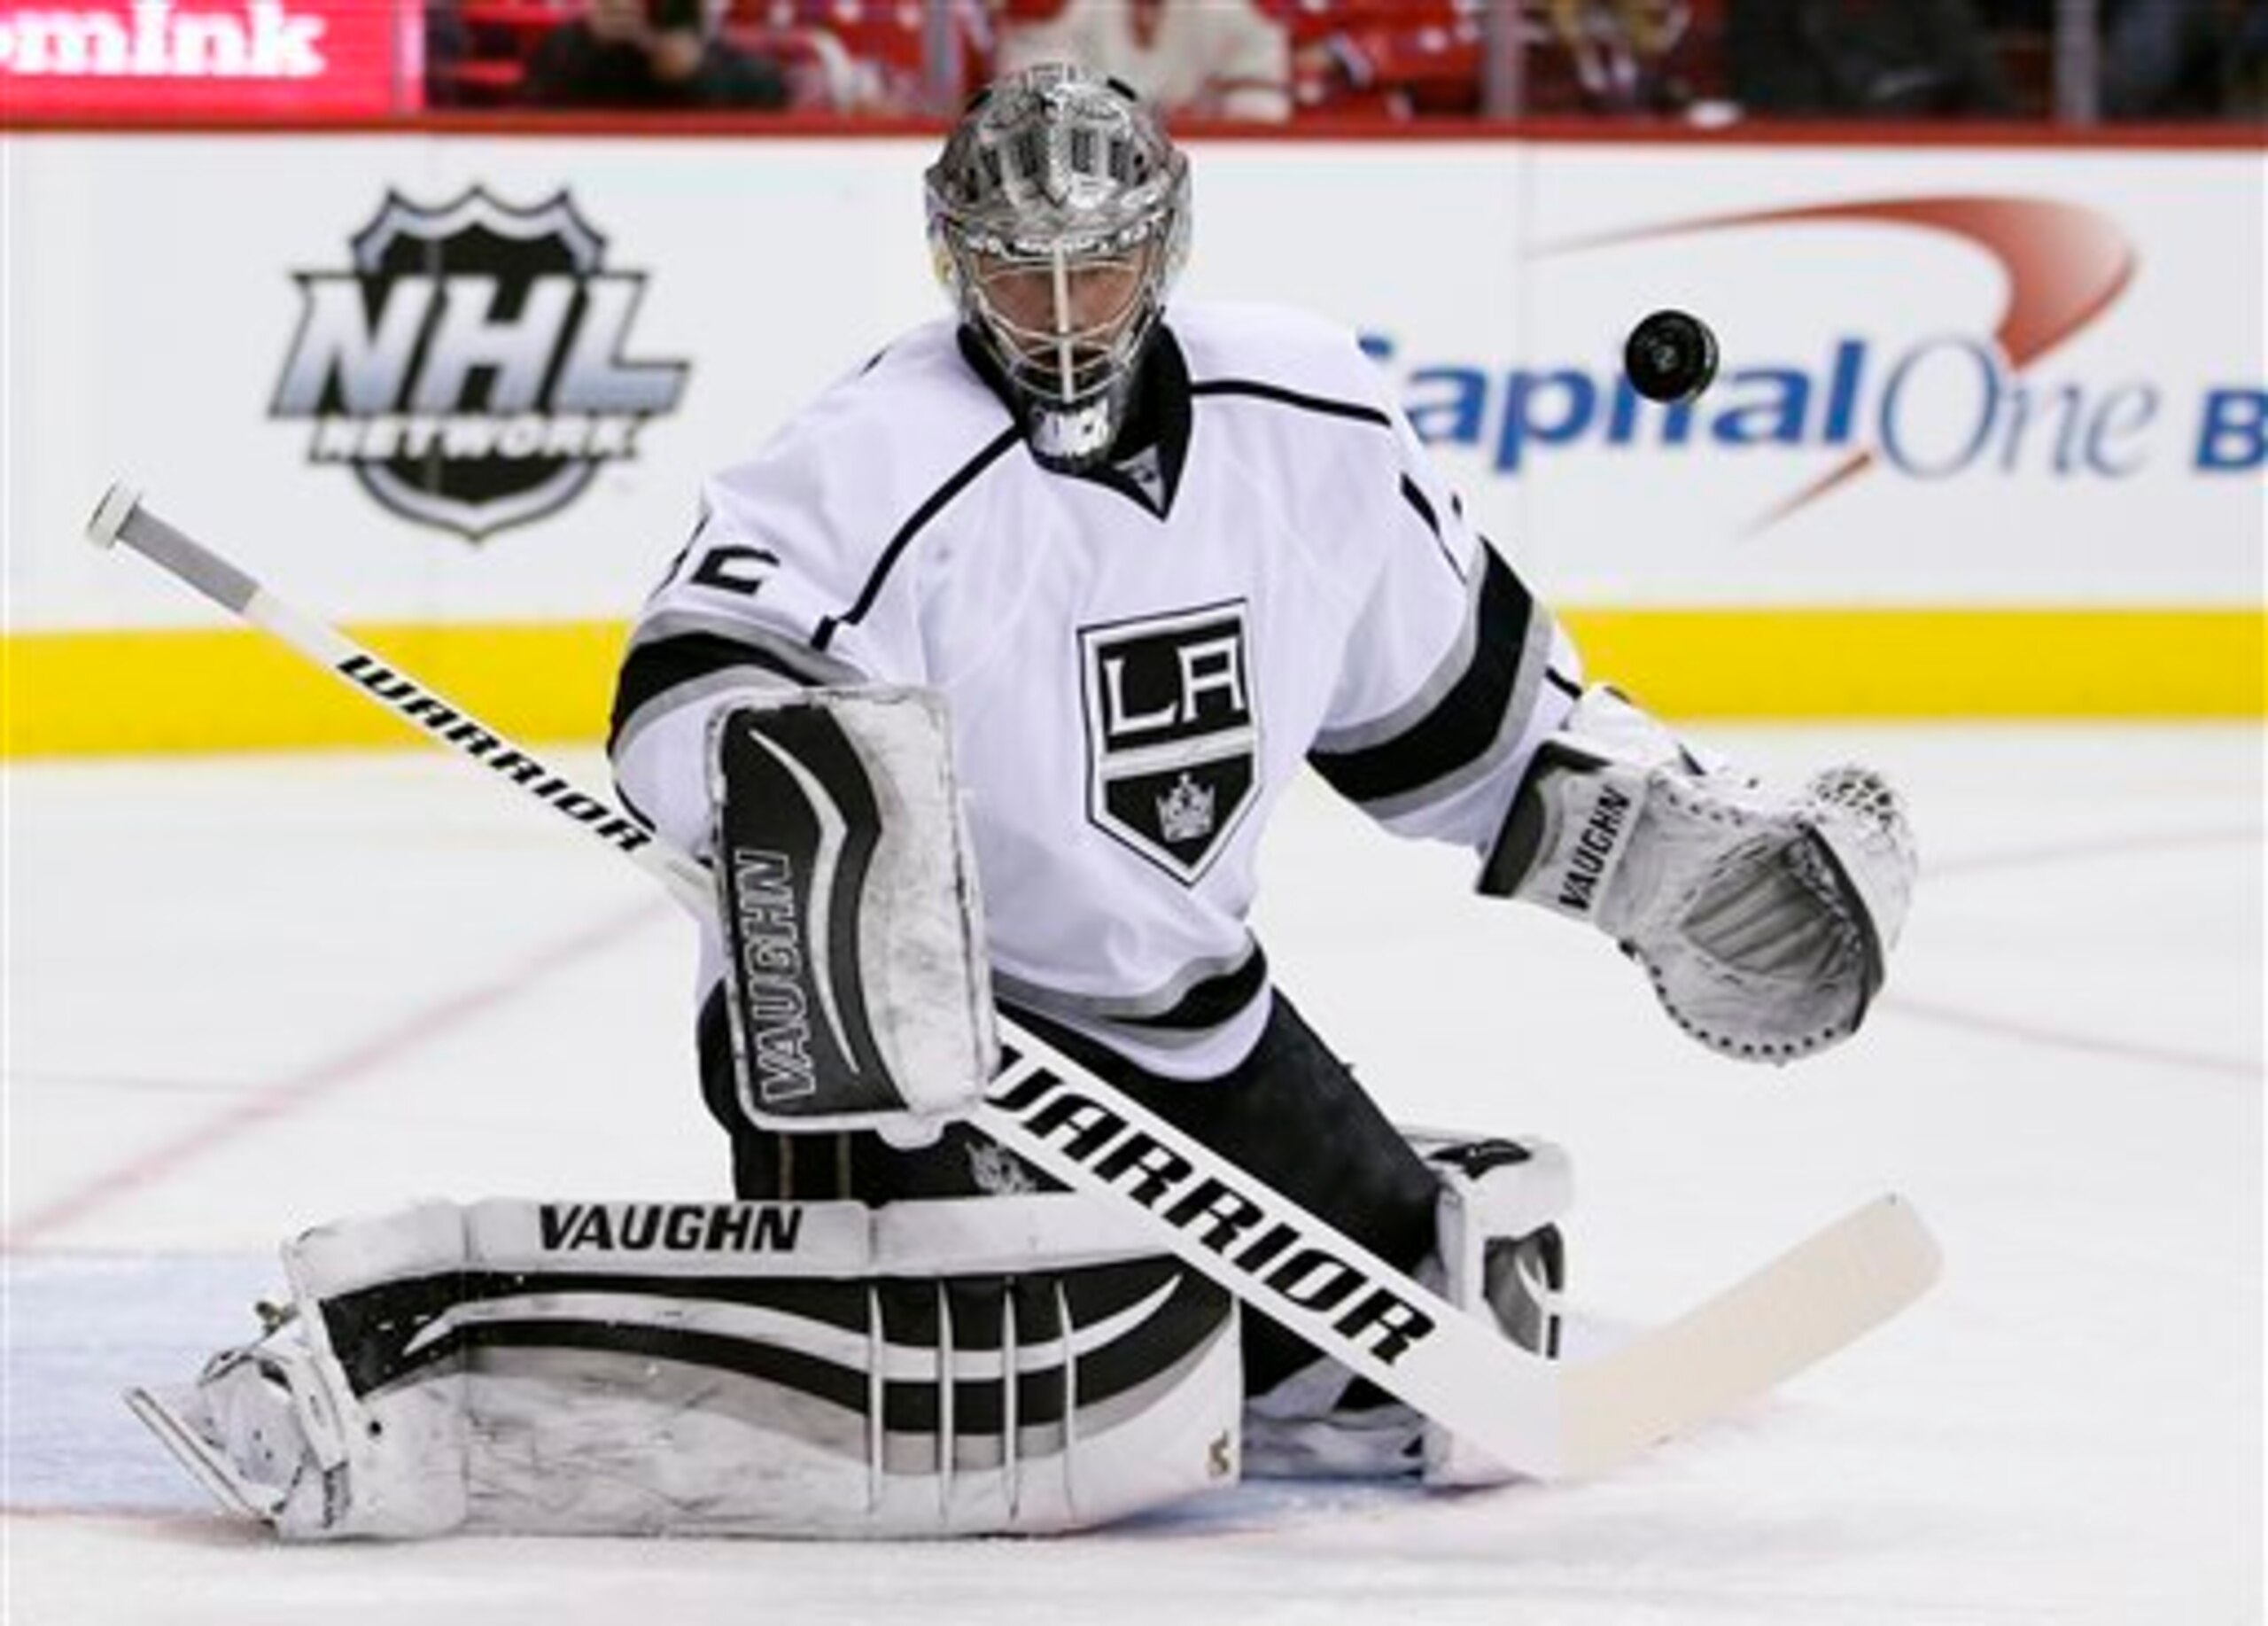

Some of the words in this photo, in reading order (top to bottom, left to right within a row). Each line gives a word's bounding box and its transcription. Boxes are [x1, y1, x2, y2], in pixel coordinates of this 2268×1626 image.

[0, 0, 328, 79] mink
[268, 271, 692, 418] NHL
[1879, 335, 2159, 479] One
[310, 413, 645, 463] NETWORK
[1104, 636, 1245, 736] LA
[337, 655, 652, 852] WARRIOR
[1557, 784, 1630, 911] VAUGHN
[734, 849, 816, 1103] VAUGHN
[539, 1203, 803, 1252] VAUGHN
